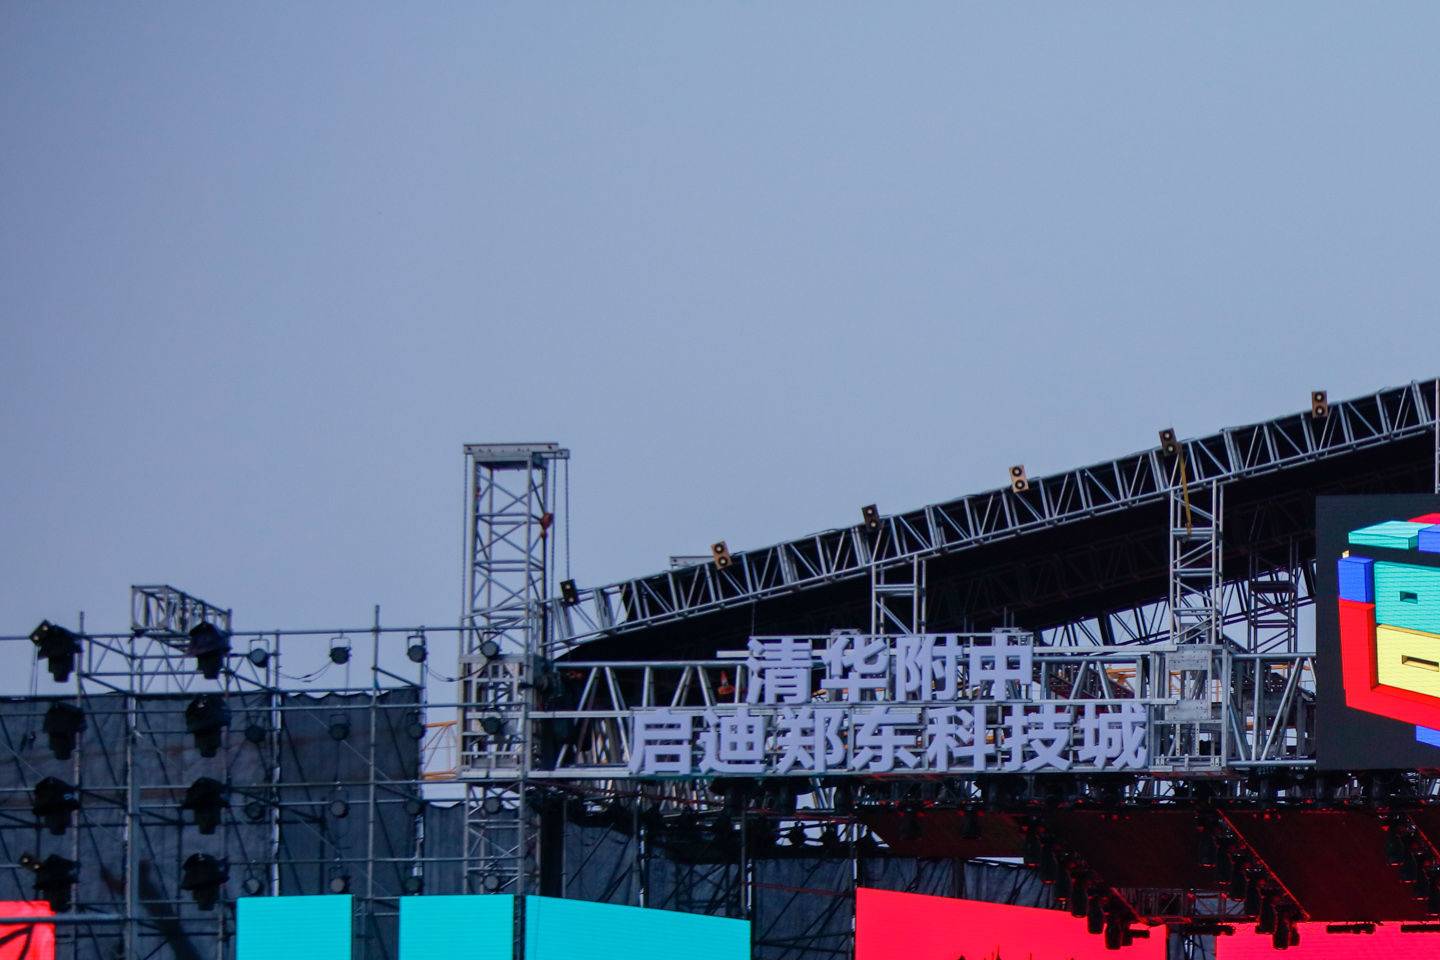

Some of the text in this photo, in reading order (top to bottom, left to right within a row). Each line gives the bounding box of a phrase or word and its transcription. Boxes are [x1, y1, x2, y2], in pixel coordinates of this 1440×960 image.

[746, 634, 1033, 703] 清华附中
[628, 703, 1149, 775] 启迪郑东科技城
